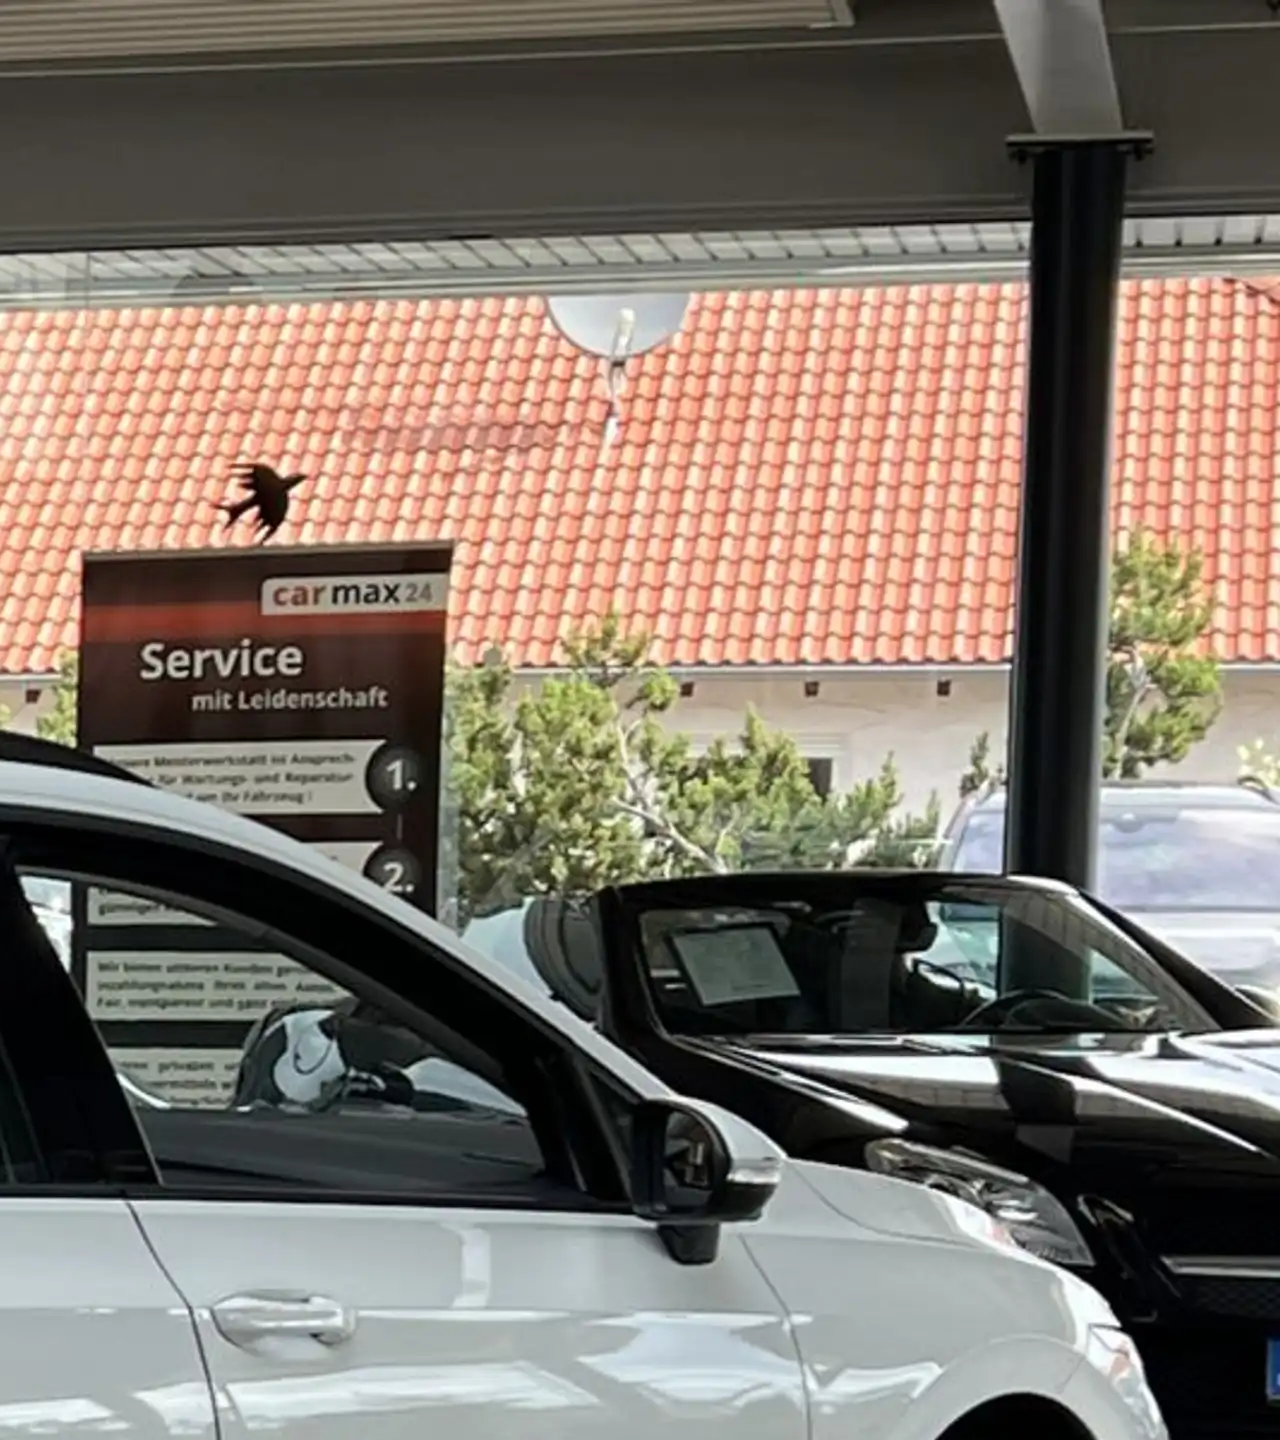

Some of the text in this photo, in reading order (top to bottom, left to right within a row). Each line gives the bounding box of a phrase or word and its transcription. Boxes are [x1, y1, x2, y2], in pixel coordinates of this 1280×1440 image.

[140, 638, 305, 680] Service
[191, 686, 389, 711] mit Leidenschaft
[386, 758, 417, 791] 1.
[383, 861, 414, 893] 2.
